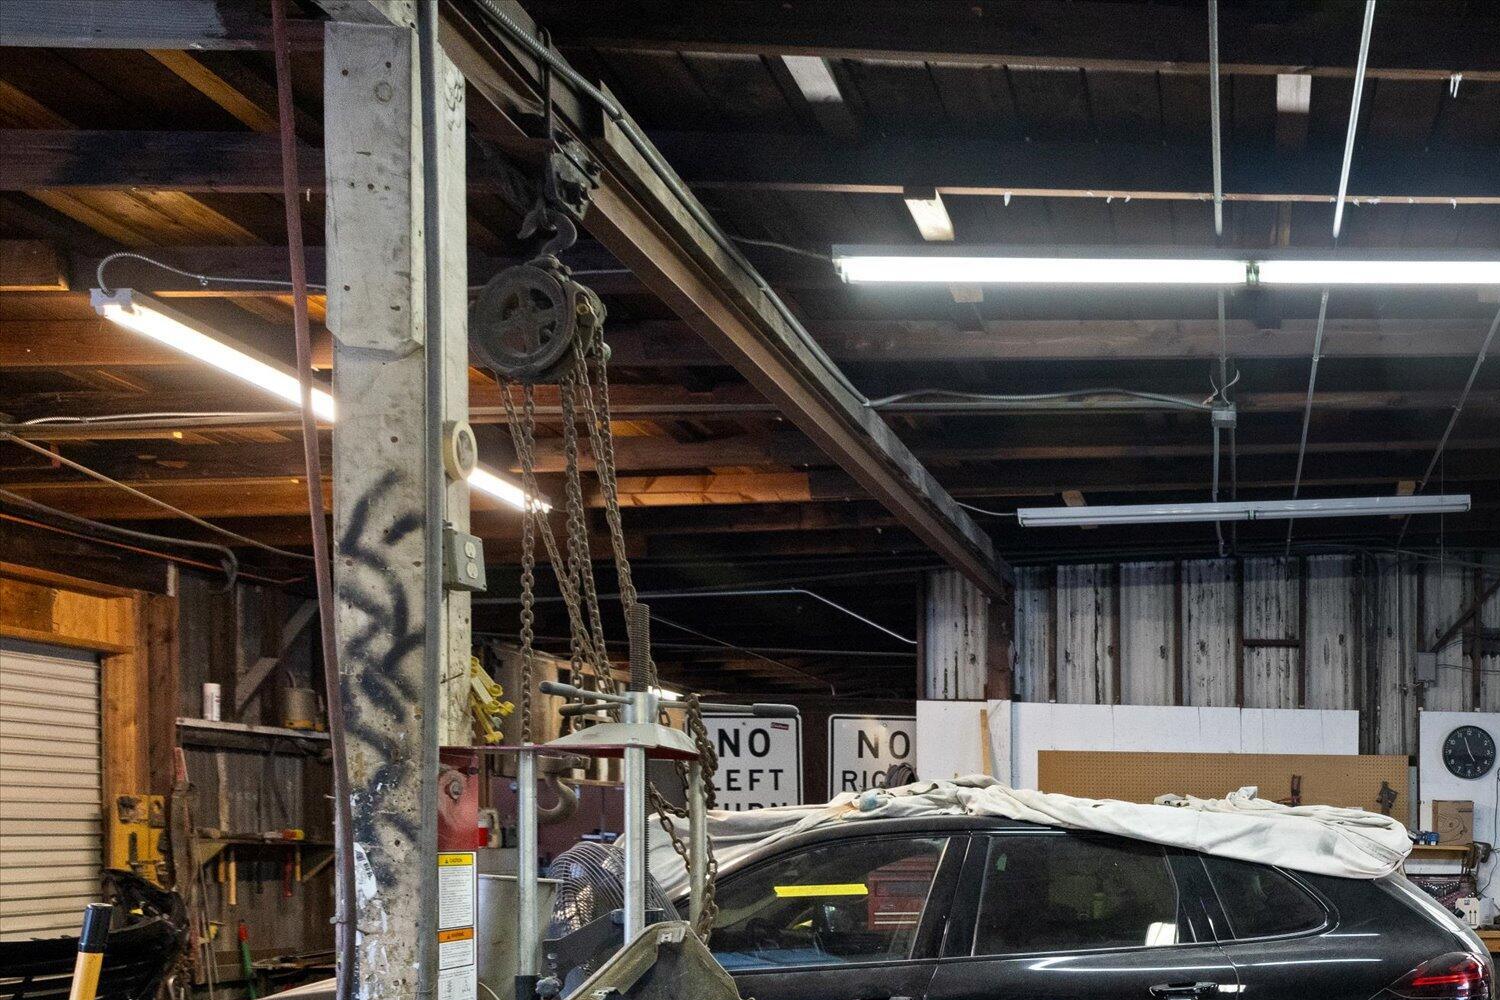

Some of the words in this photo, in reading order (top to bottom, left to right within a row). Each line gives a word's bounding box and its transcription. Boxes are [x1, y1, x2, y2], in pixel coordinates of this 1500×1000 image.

[717, 728, 771, 758] NO
[857, 730, 911, 759] NO
[714, 769, 784, 791] EFT
